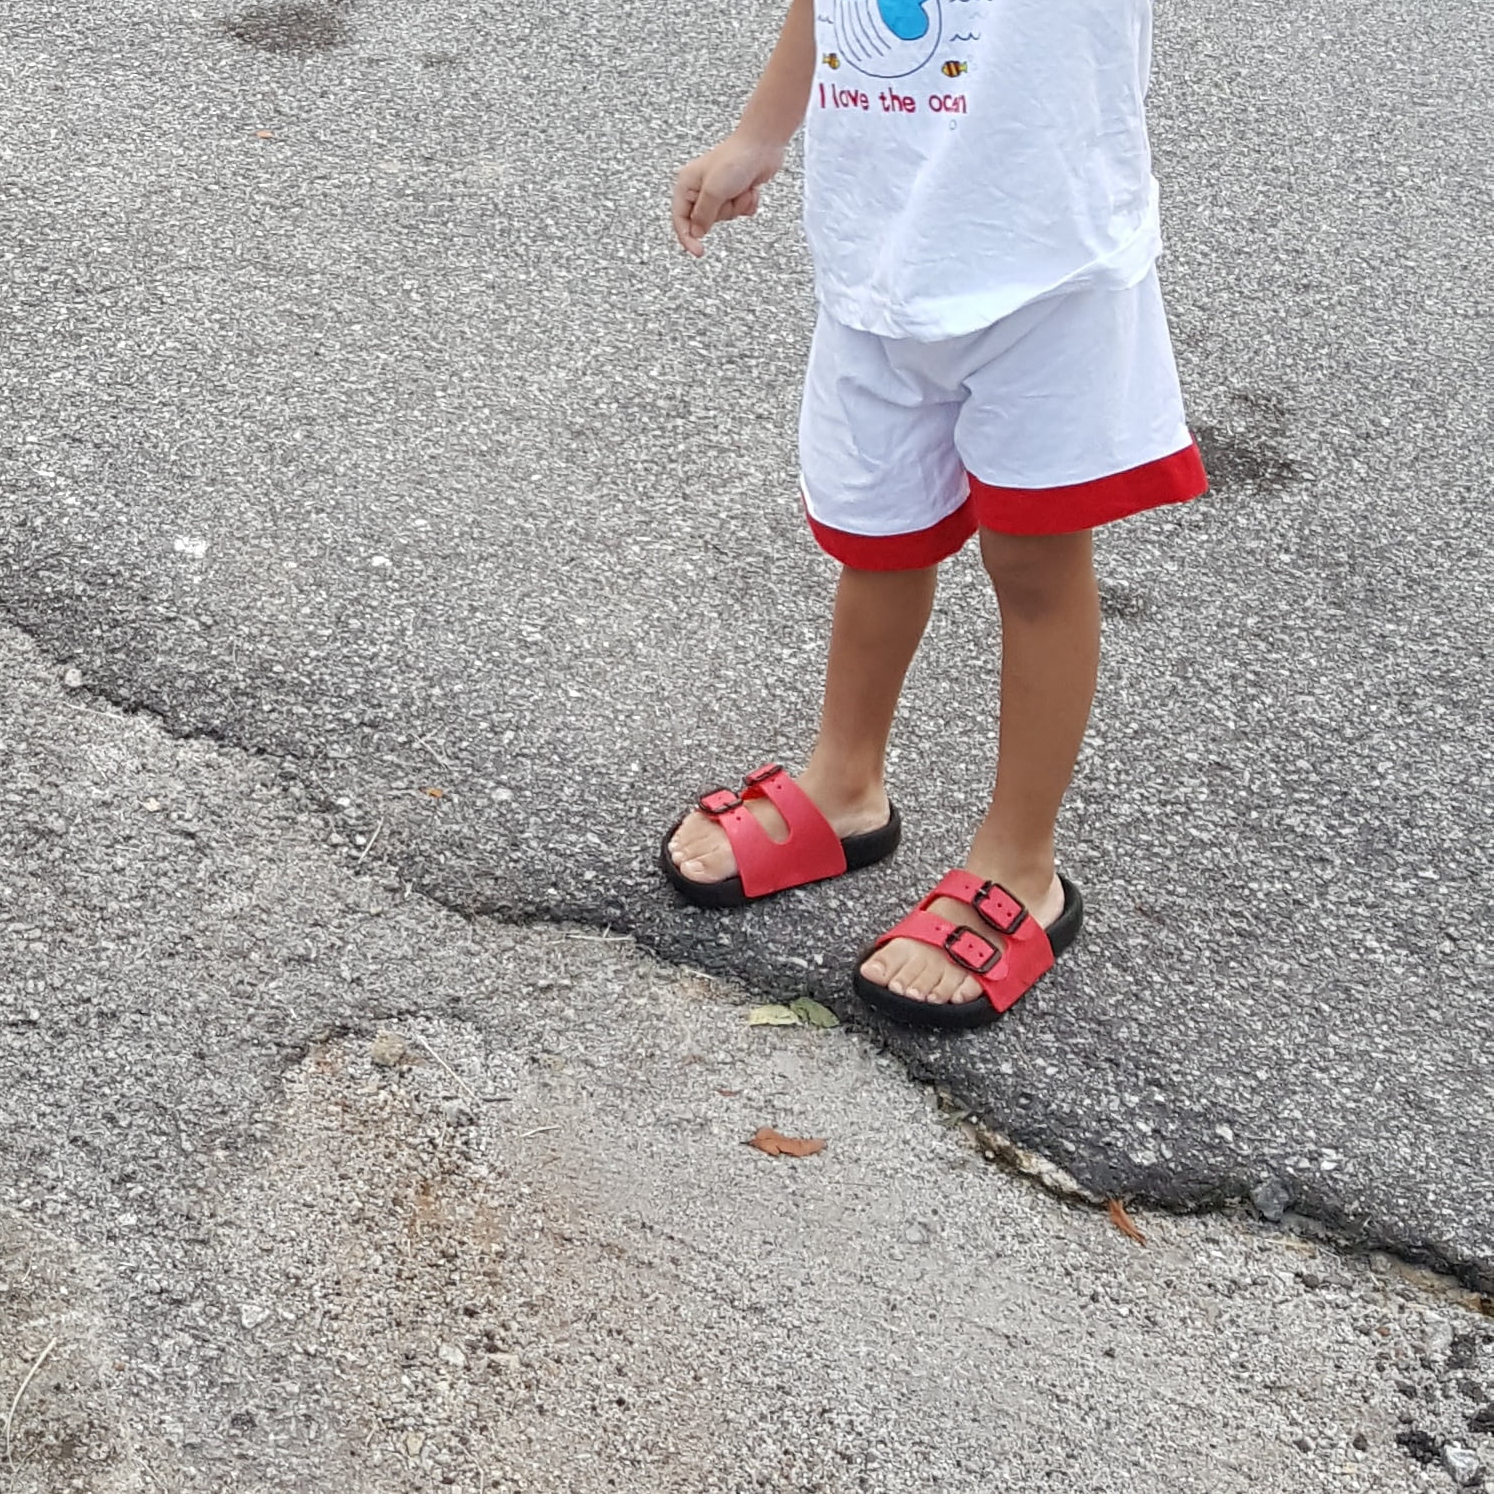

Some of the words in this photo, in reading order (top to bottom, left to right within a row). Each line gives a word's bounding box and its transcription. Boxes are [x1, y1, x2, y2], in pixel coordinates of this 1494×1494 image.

[818, 82, 826, 109] I
[831, 83, 870, 111] love
[878, 87, 916, 114] the
